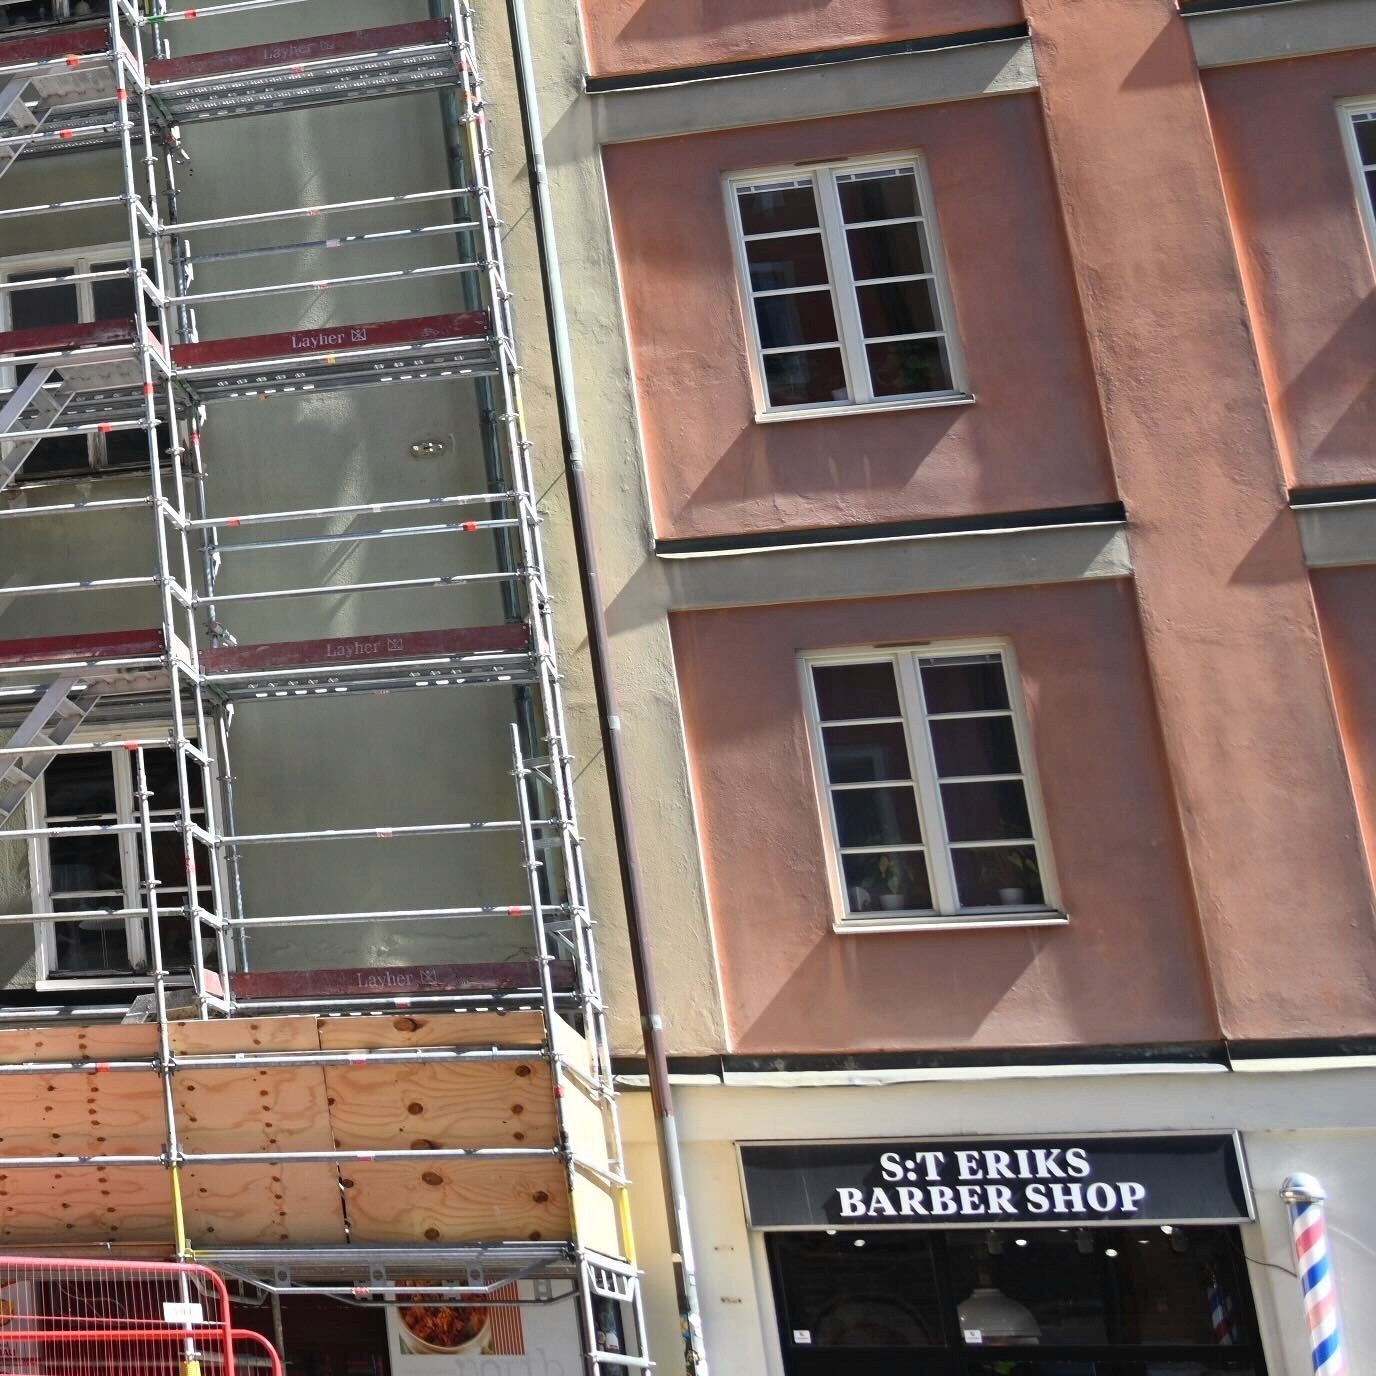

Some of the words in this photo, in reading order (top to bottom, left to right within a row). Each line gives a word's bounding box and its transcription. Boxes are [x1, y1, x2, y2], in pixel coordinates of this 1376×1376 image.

[292, 332, 345, 349] Layher
[327, 642, 378, 658] Layher
[357, 971, 413, 989] Layher
[879, 1151, 945, 1181] S:T
[954, 1147, 1091, 1179] ERIKS
[835, 1183, 1018, 1216] BARBER
[1025, 1181, 1146, 1214] SHOP
